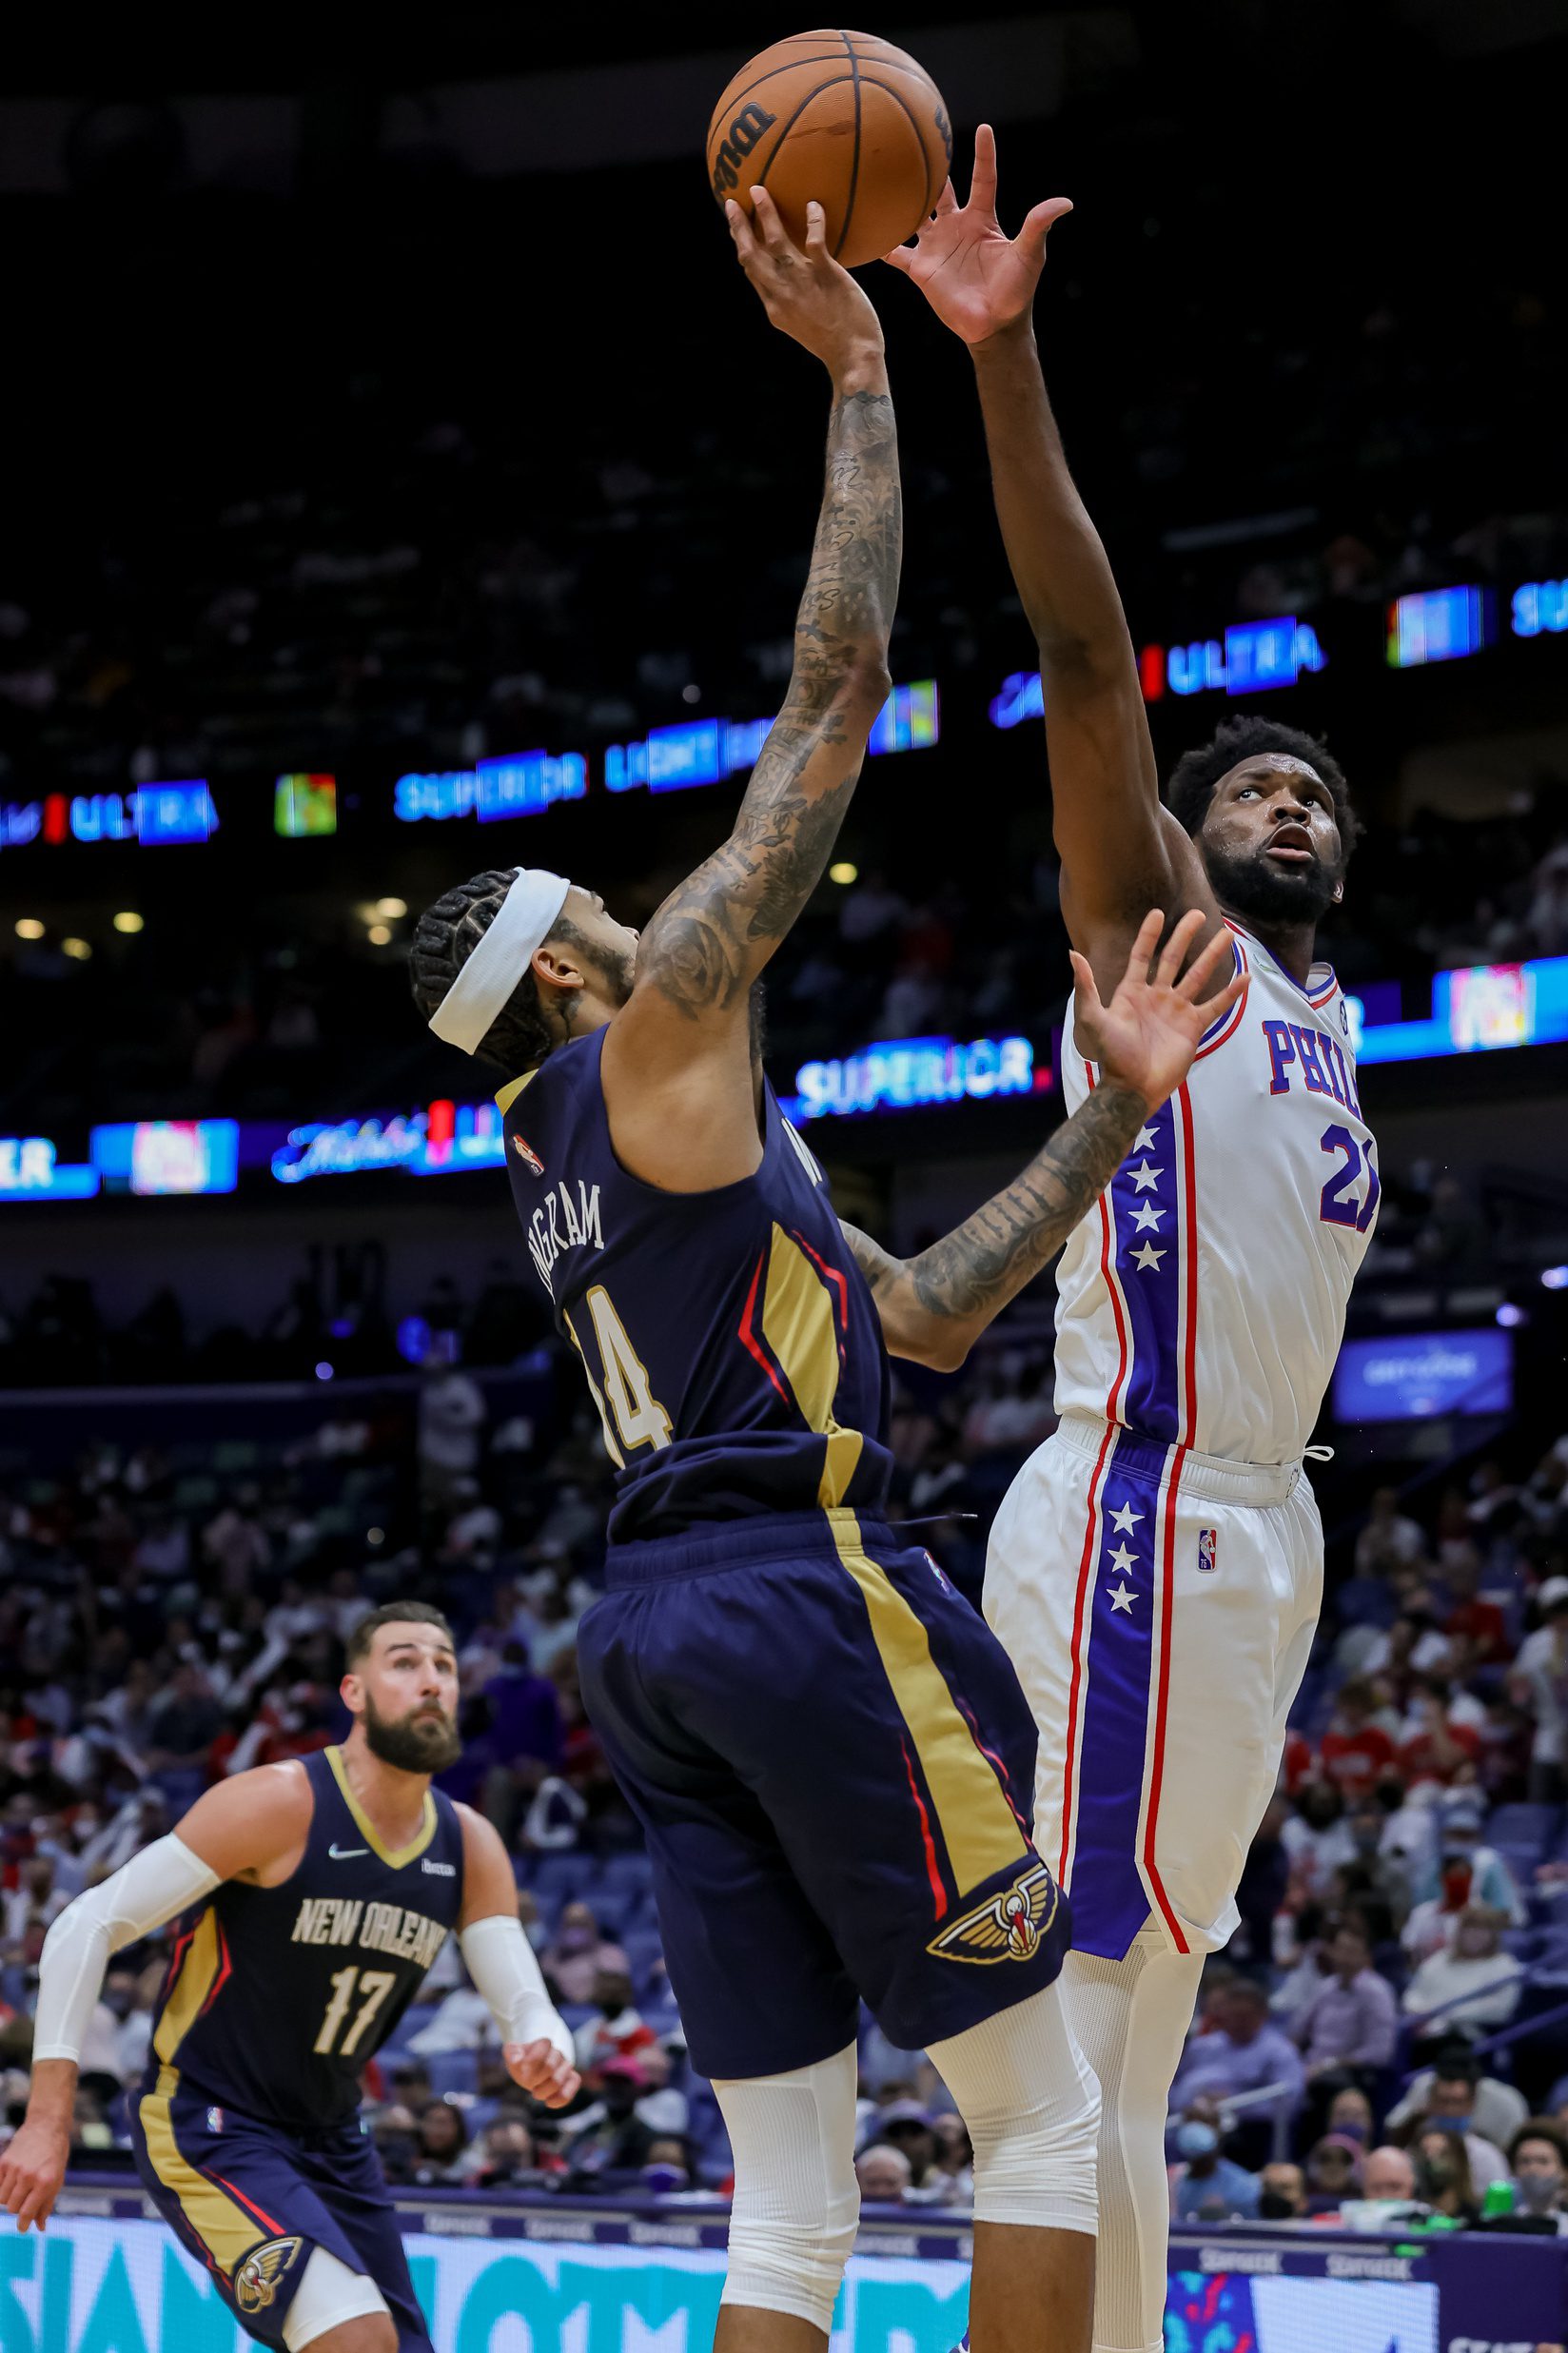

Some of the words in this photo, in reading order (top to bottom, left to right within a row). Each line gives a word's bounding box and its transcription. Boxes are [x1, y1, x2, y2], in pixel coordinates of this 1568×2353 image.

[1263, 1020, 1364, 1123] PHIL
[1320, 1124, 1382, 1234] 21
[528, 1179, 605, 1305] NGRAM
[291, 1898, 364, 1946] NEW
[359, 1902, 449, 1971] ORLEAN
[313, 1966, 397, 2055] 17
